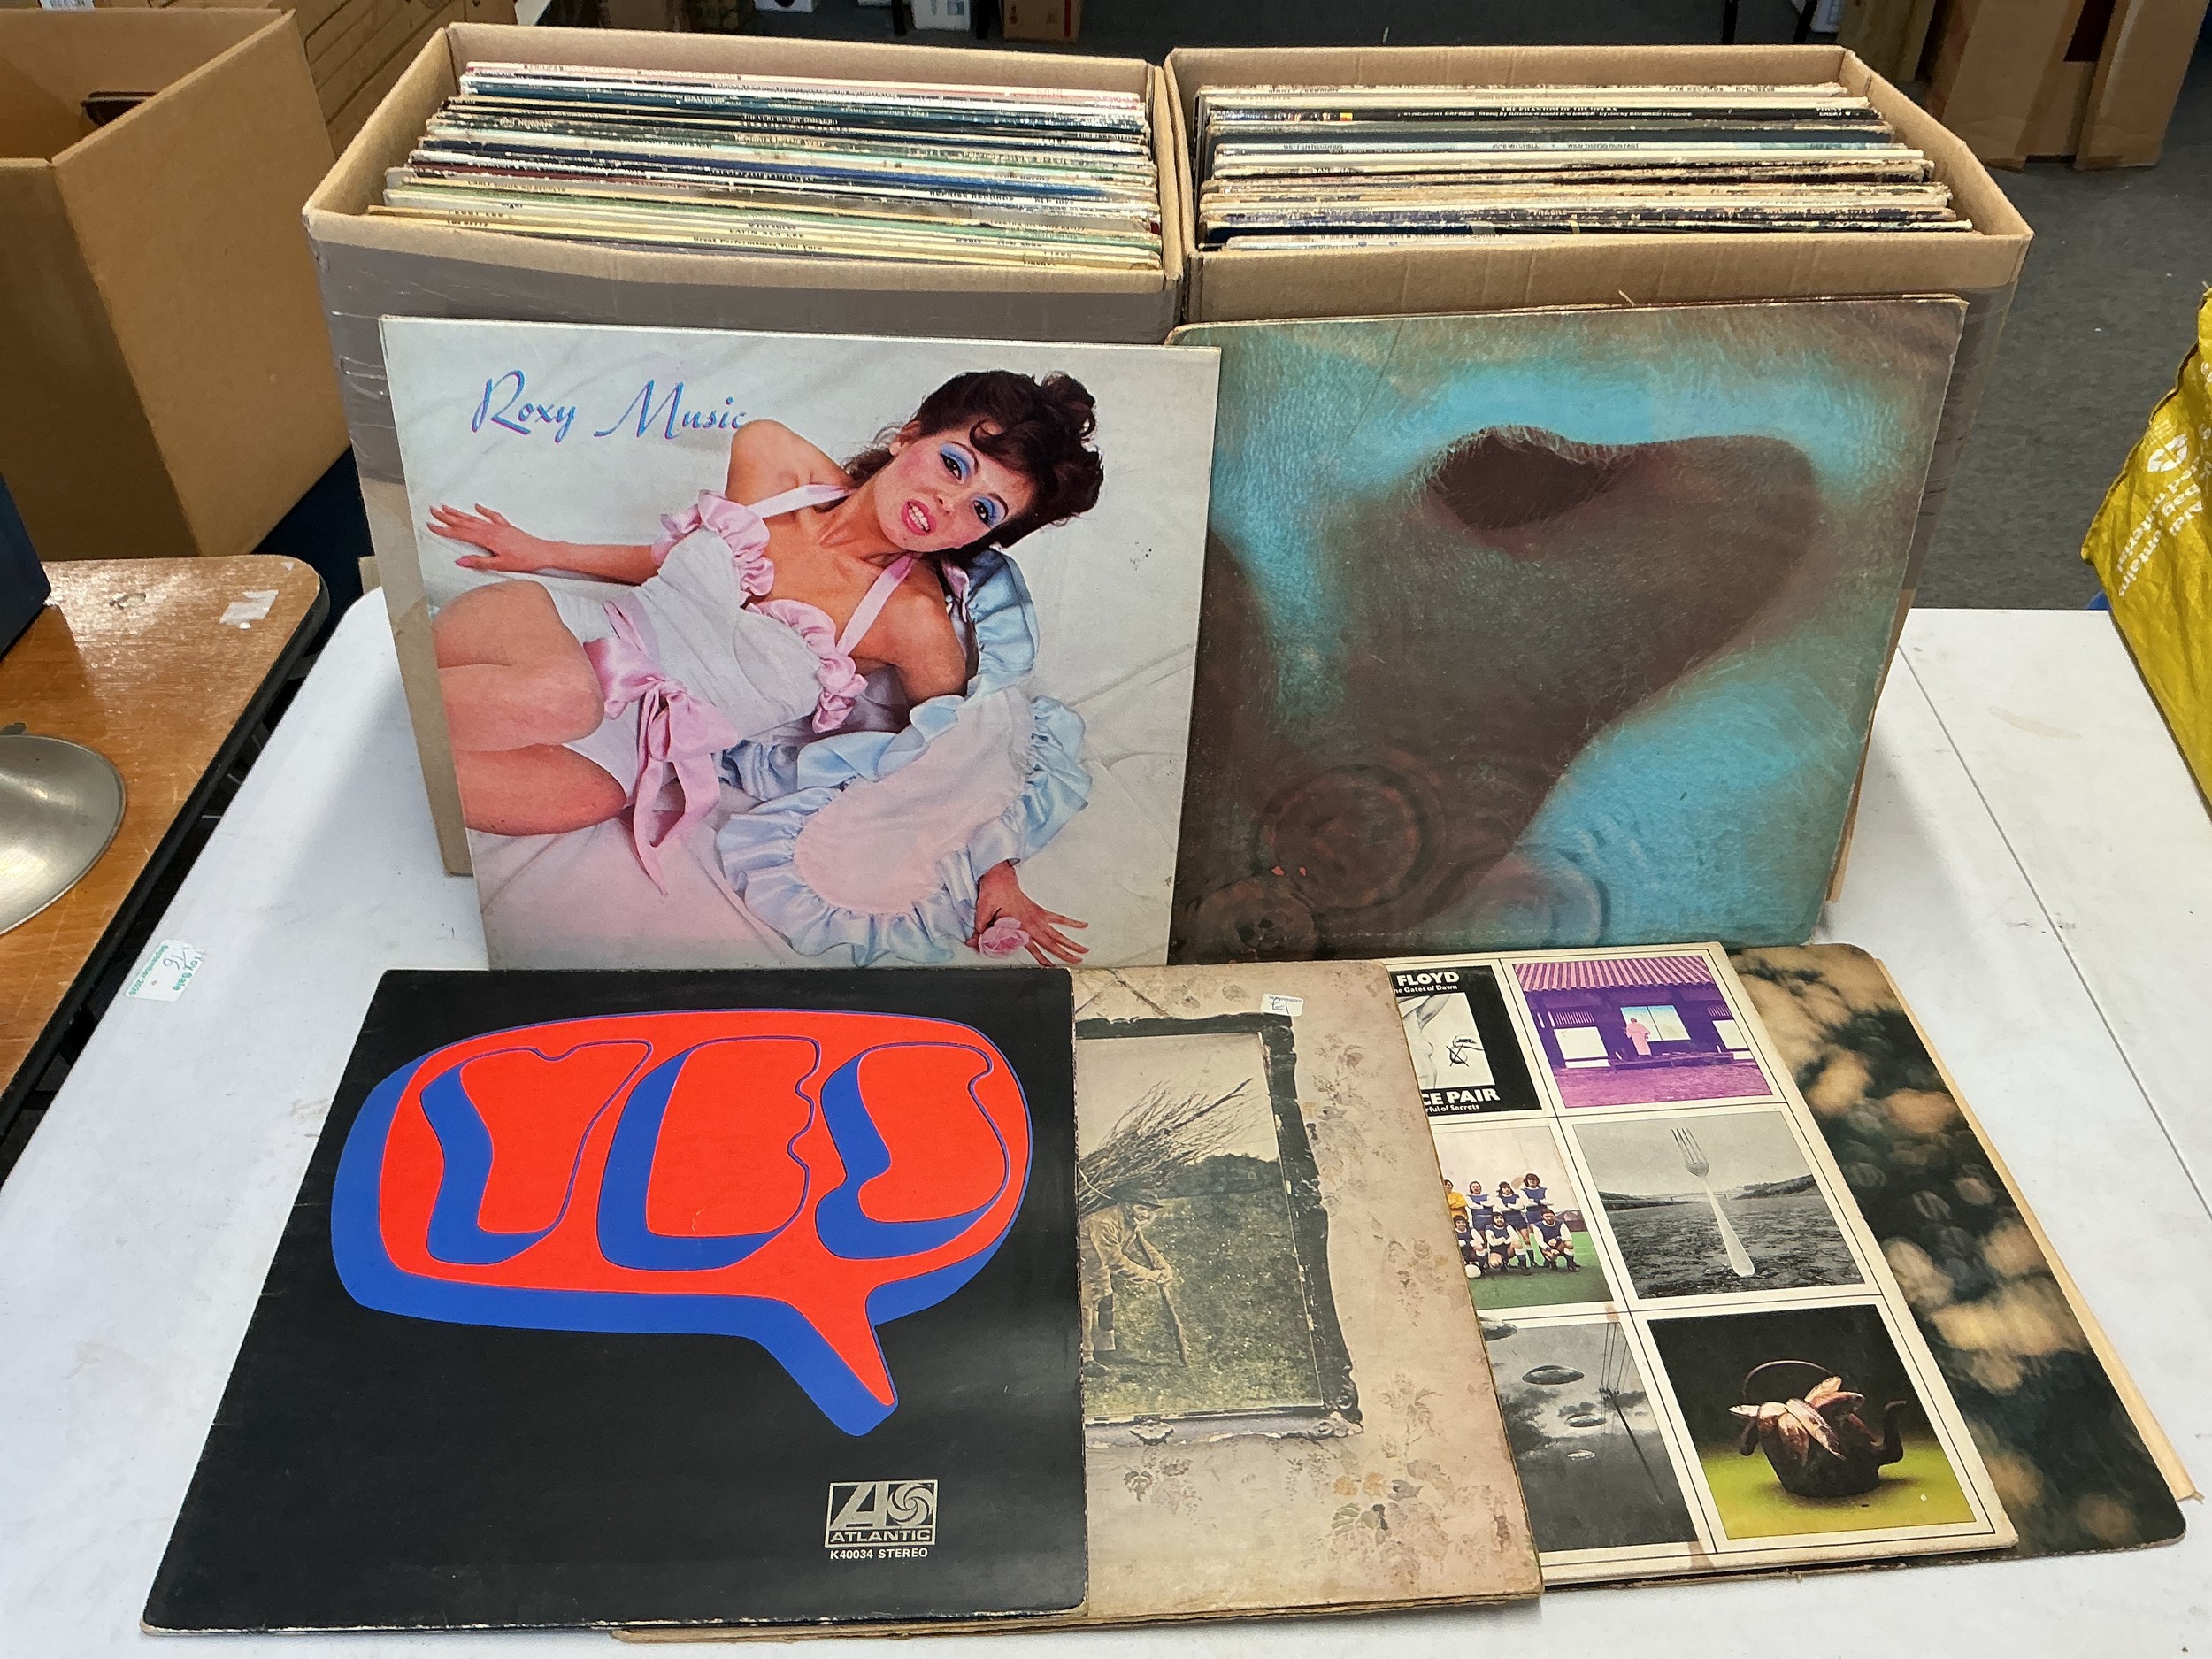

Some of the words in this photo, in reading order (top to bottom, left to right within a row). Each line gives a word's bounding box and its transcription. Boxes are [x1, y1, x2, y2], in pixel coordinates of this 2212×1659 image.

[472, 369, 577, 444] Roxy
[594, 379, 748, 440] Music
[2161, 483, 2201, 517] bag
[2117, 492, 2167, 572] mterial
[1396, 972, 1460, 987] FLOYD
[1422, 1092, 1444, 1106] CE
[1446, 1088, 1501, 1104] PAIR
[1450, 1103, 1480, 1112] Secrets
[830, 1529, 932, 1543] ATLANTIC
[830, 1548, 874, 1560] K40034
[878, 1548, 928, 1559] STEREO
